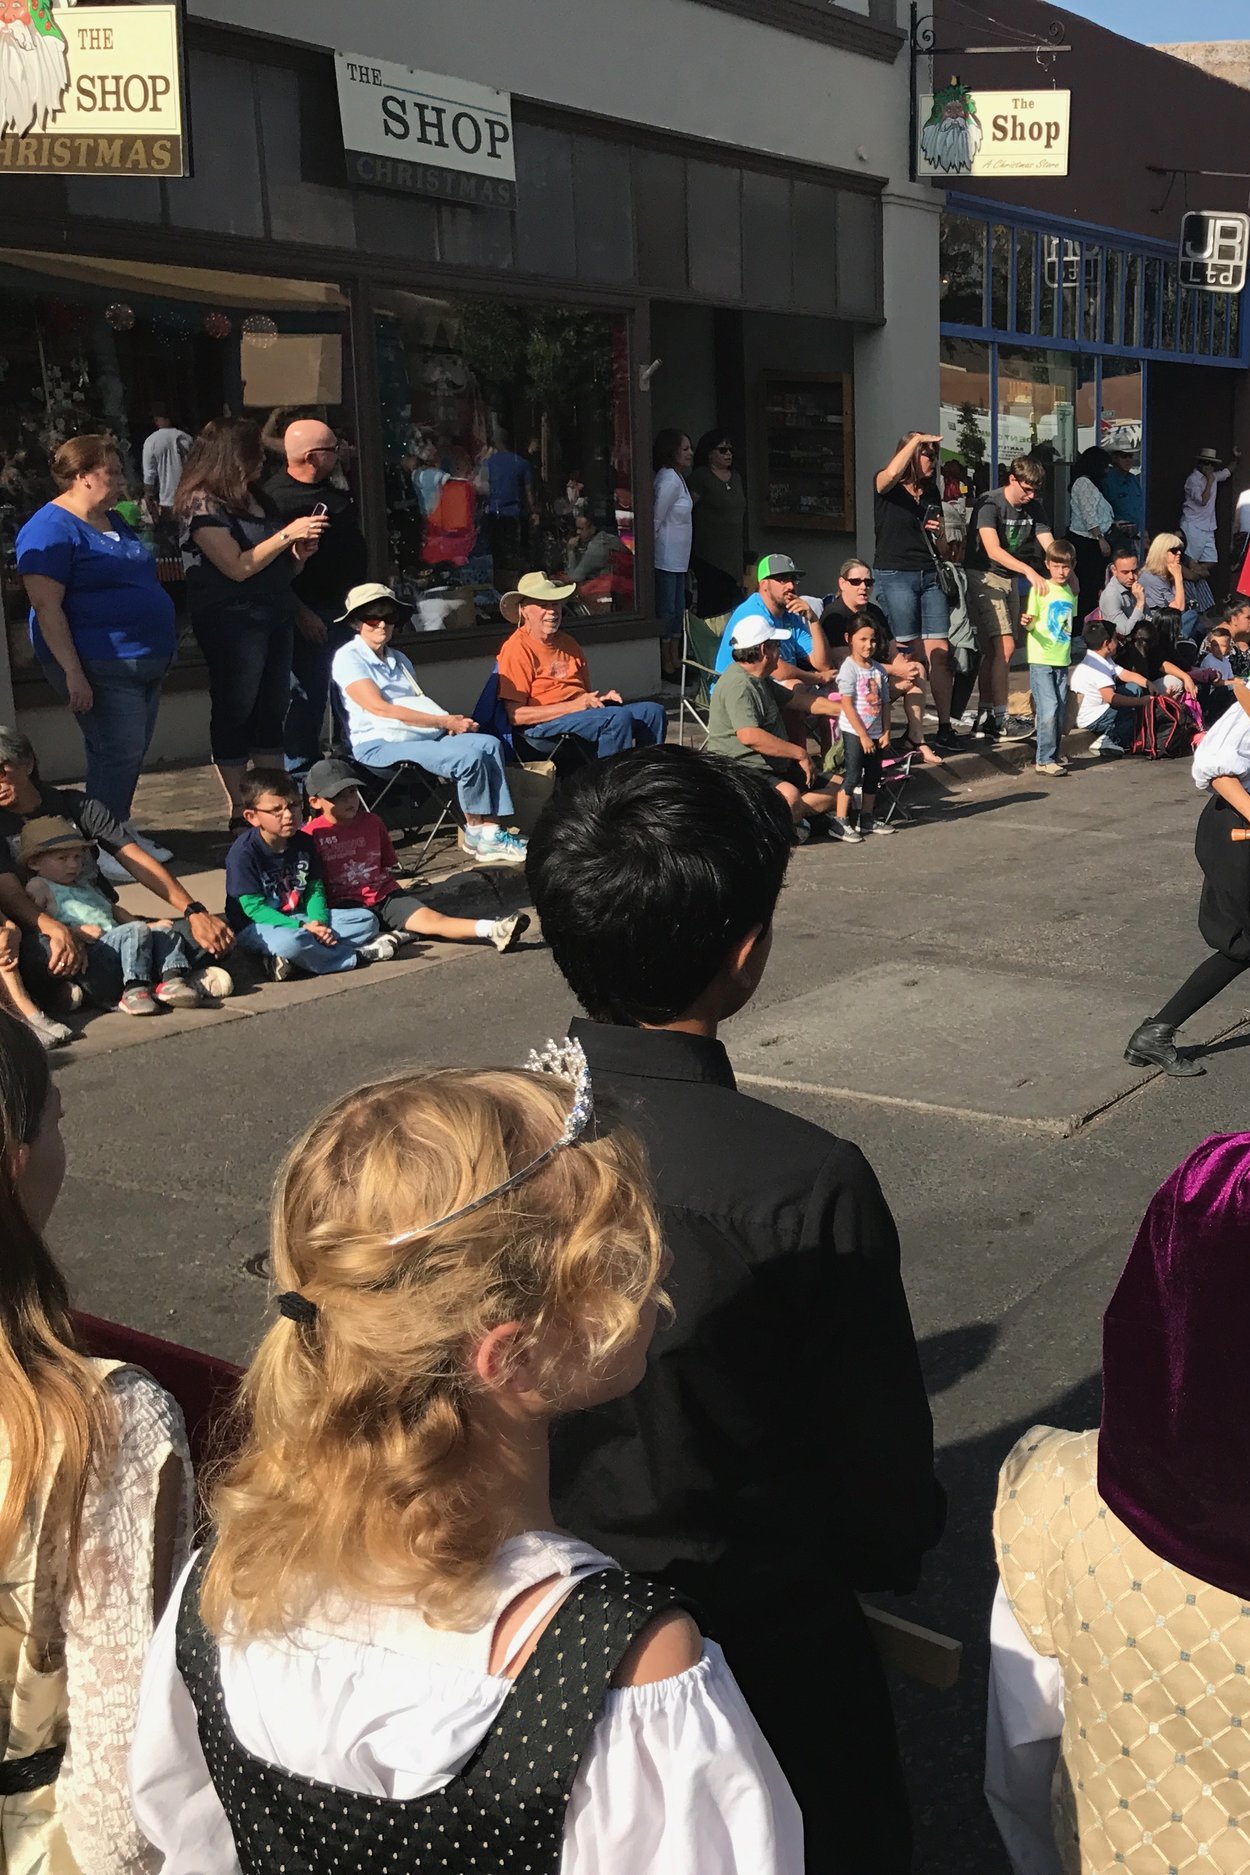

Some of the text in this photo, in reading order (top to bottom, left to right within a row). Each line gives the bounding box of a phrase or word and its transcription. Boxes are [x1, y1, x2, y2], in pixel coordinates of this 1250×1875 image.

[78, 28, 113, 50] THE
[347, 63, 382, 86] THE
[76, 74, 170, 113] SHOP
[1012, 98, 1035, 109] The
[381, 95, 509, 159] SHOP
[991, 114, 1060, 149] Shop
[0, 138, 171, 169] HRISTMAS
[983, 159, 1060, 169] A Christmas Store
[357, 156, 510, 204] CHRISTMAS
[1189, 262, 1234, 285] Ltd
